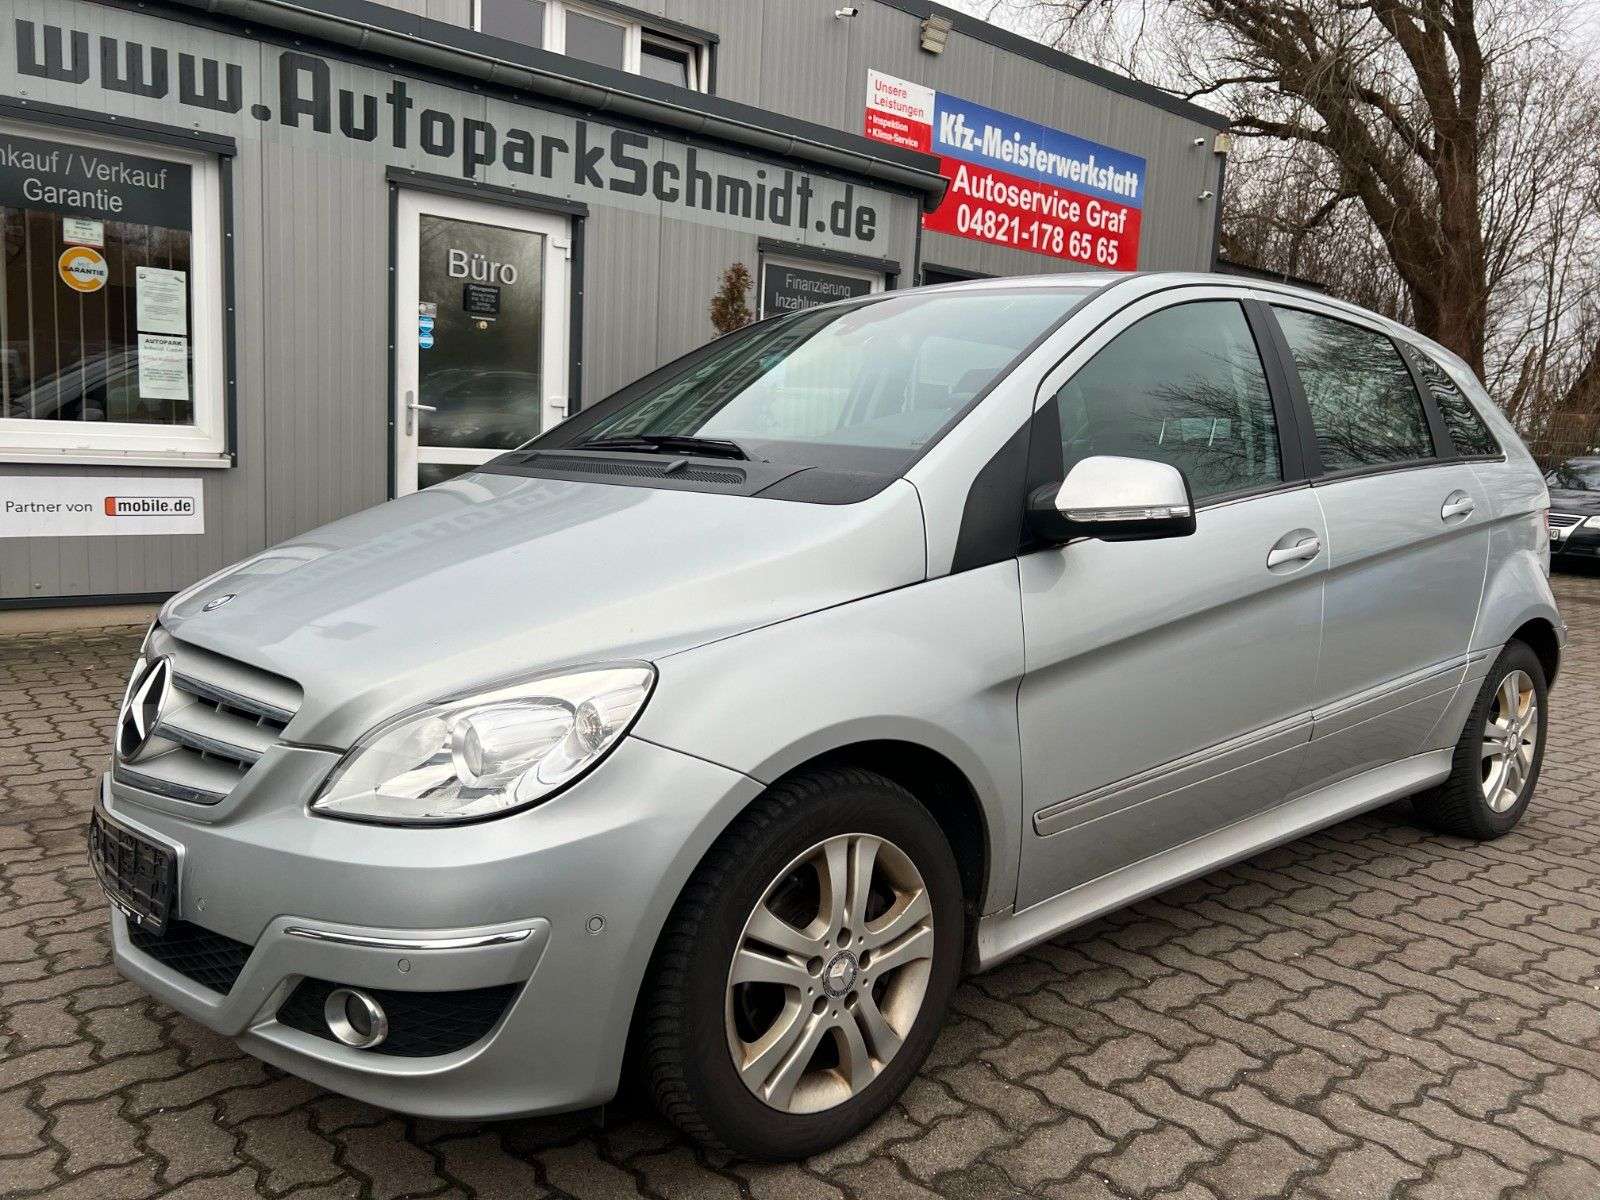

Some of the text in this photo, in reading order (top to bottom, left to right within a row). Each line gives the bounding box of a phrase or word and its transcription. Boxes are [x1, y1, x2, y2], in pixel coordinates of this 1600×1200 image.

[874, 95, 924, 118] Leistungen
[875, 79, 907, 99] Unsere
[15, 18, 876, 242] www.AutoparkSchmidt.de
[939, 110, 1139, 199] Kfz-Meisterwerkstatt
[80, 155, 168, 191] Verkauf
[22, 177, 123, 213] Garantie
[952, 164, 1128, 234] Autoservice Graf
[956, 203, 1064, 254] 04821-178
[1068, 230, 1092, 260] 65
[1096, 238, 1119, 266] 65
[63, 265, 105, 276] GARANTIE
[448, 248, 518, 285] Büro
[775, 291, 825, 311] Inzahlun
[785, 273, 851, 298] Finanzierung
[5, 499, 192, 513] Partner von mobile.de
